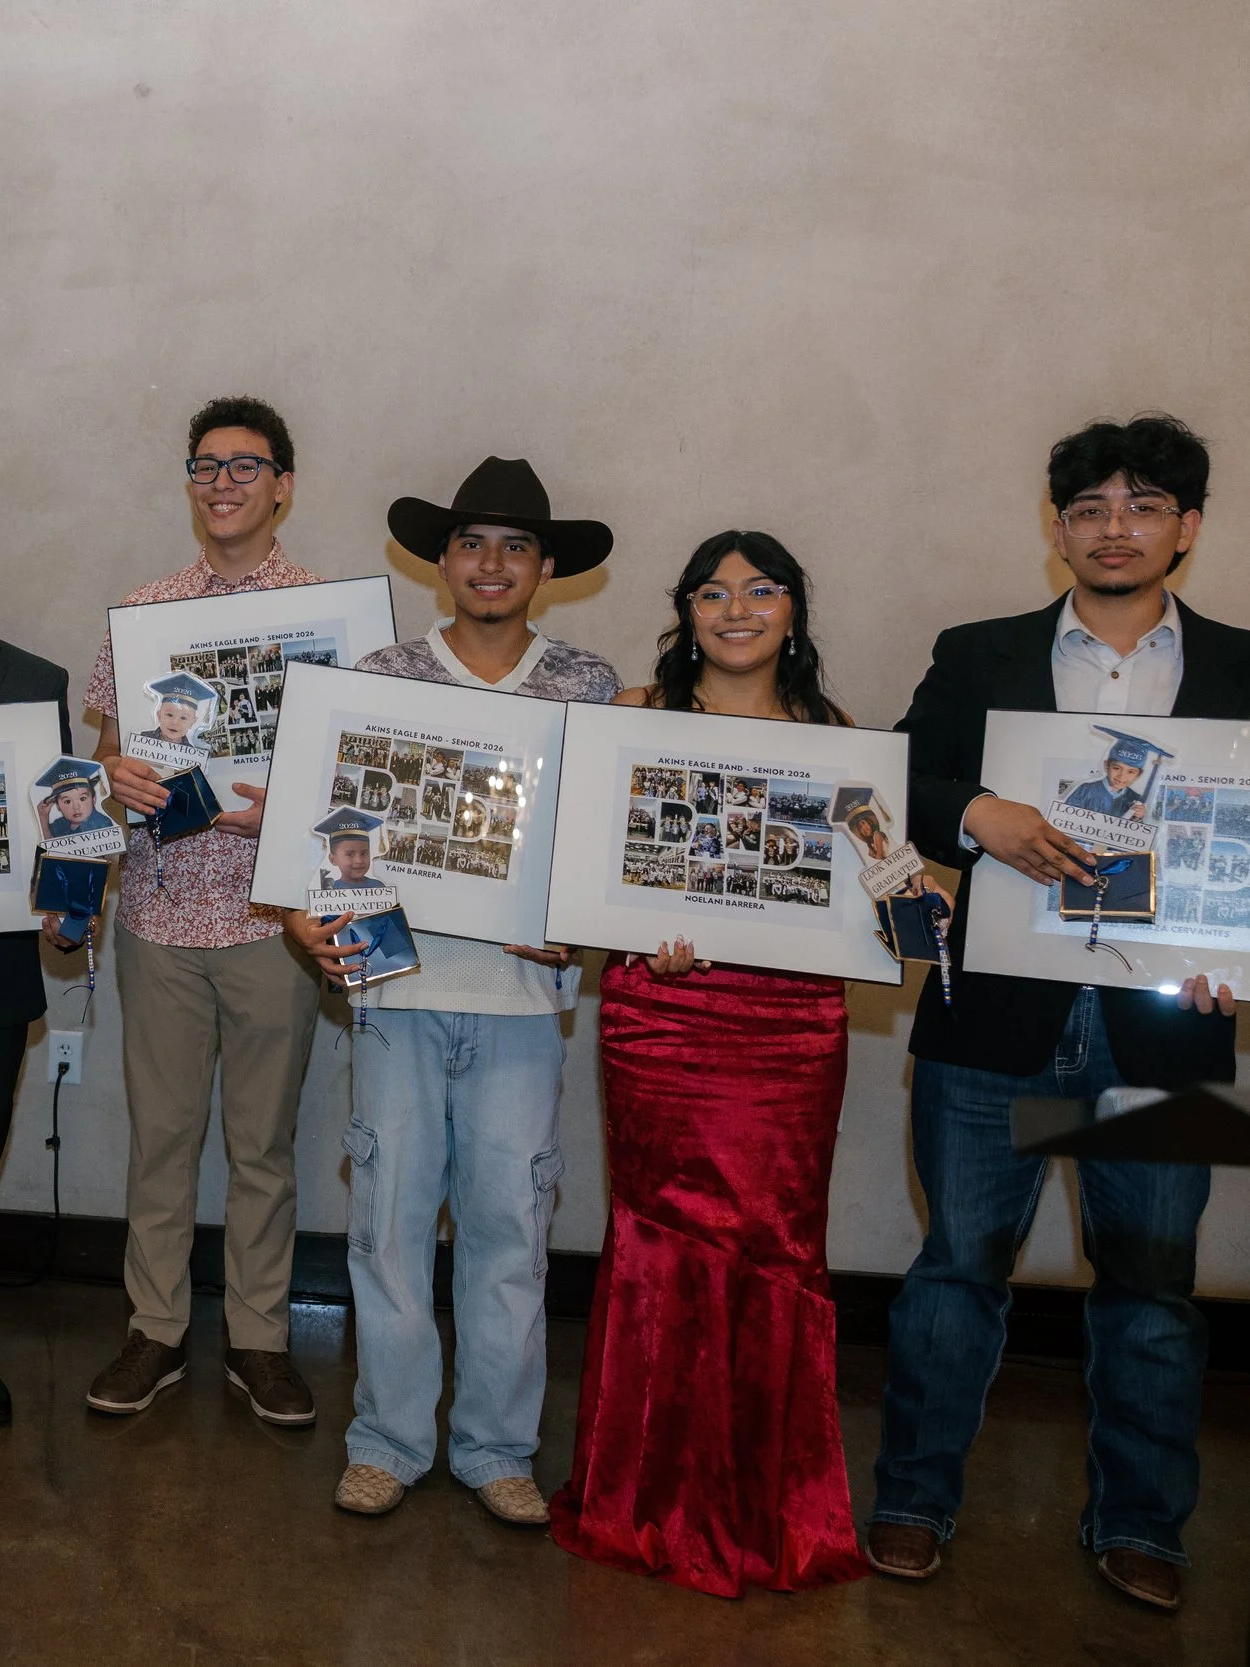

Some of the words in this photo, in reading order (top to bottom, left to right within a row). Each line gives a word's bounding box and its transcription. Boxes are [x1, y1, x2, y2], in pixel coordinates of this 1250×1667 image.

[190, 642, 212, 650] AKINS
[214, 639, 237, 647] EAGLE
[240, 636, 260, 644] BAND
[268, 633, 294, 641] SENIOR
[296, 630, 314, 638] 2026
[174, 687, 192, 695] 2026
[134, 735, 163, 748] LOOK
[169, 744, 205, 757] WHO'S
[365, 724, 391, 734] AKINS
[393, 728, 418, 739] EAGLE
[421, 733, 443, 742] BAND
[451, 738, 480, 748] SENIOR
[483, 743, 504, 752] 2026
[1118, 750, 1142, 760] 2026
[58, 772, 78, 780] 2026
[658, 757, 685, 766] AKINS
[688, 760, 715, 769] EAGLE
[718, 763, 743, 772] BAND
[753, 767, 785, 776] SENIOR
[788, 770, 811, 778] 2026
[1162, 774, 1186, 782] AND
[1198, 776, 1235, 784] SENIOR
[1055, 804, 1097, 820] LOOK
[1103, 815, 1152, 834] WHO'S
[44, 838, 77, 849] LOOK
[80, 828, 119, 843] WHO'S
[1053, 818, 1145, 848] GRADUATED
[386, 864, 405, 873] YAIN
[407, 868, 442, 879] BARRERA
[862, 865, 885, 881] LOOK
[885, 845, 912, 866] WHO'S
[872, 859, 918, 894] GRADUATED
[313, 890, 347, 898] LOOK
[350, 888, 393, 896] WHO'S
[315, 901, 392, 912] GRADUATED
[685, 895, 723, 905] NOELANI
[725, 900, 765, 910] BARRERA
[1171, 926, 1230, 938] CERVANTES
